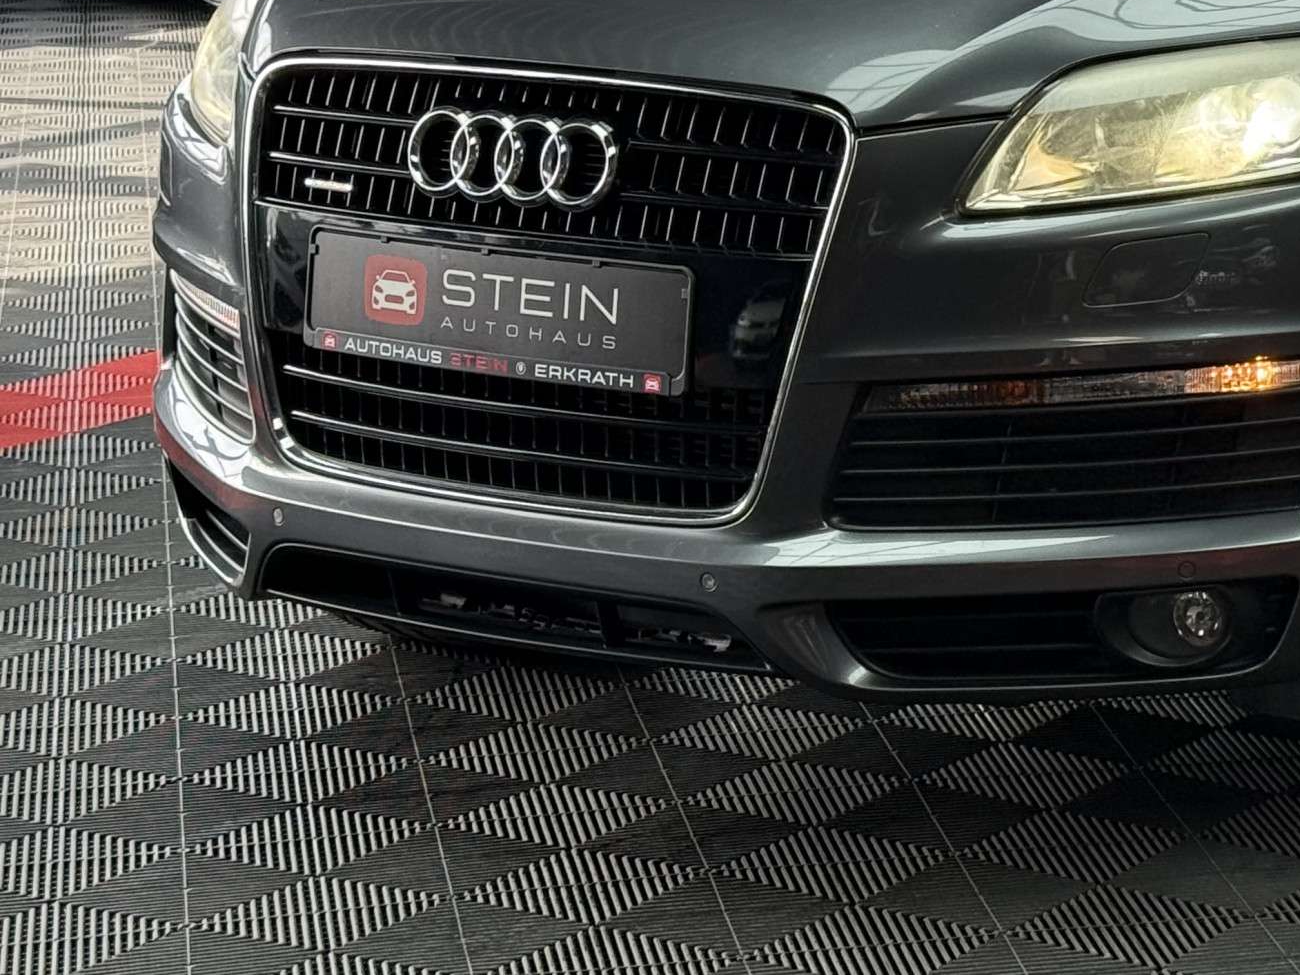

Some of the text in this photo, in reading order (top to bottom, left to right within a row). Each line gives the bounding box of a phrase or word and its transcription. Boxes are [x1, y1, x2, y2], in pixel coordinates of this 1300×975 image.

[441, 268, 620, 326] STEIN
[440, 315, 617, 350] AUTOHAUS
[344, 337, 634, 388] AUTOHAUS STEIN ERKRATH
